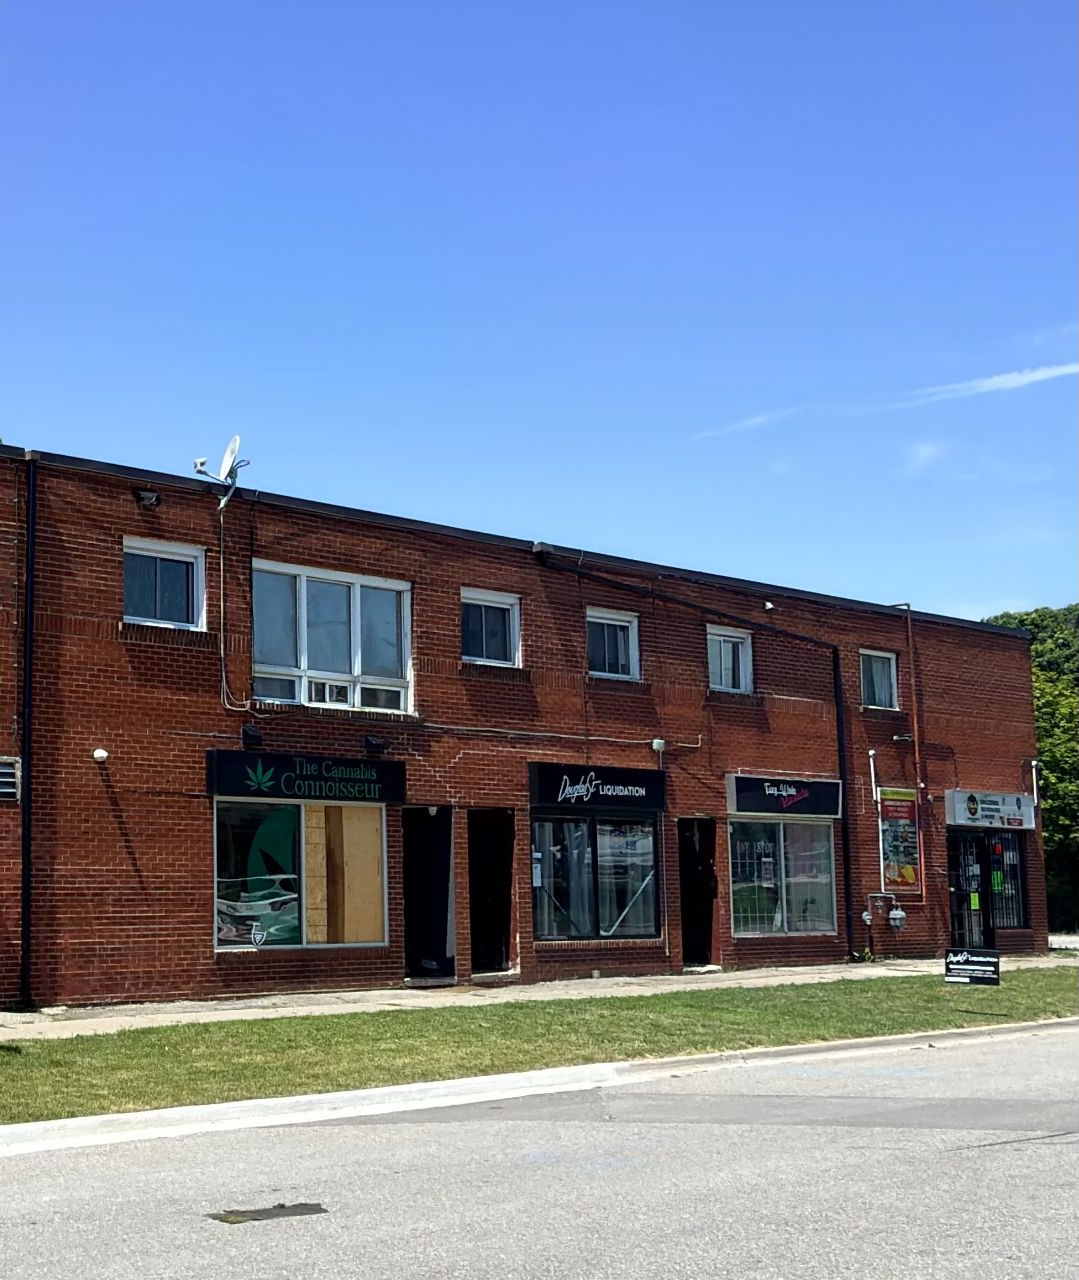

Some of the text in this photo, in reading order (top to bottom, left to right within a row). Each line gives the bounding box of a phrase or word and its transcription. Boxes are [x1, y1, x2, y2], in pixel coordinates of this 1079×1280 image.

[293, 757, 377, 780] The Cannabis
[281, 772, 382, 799] Connoisseur
[600, 785, 646, 796] LIQUIDATION
